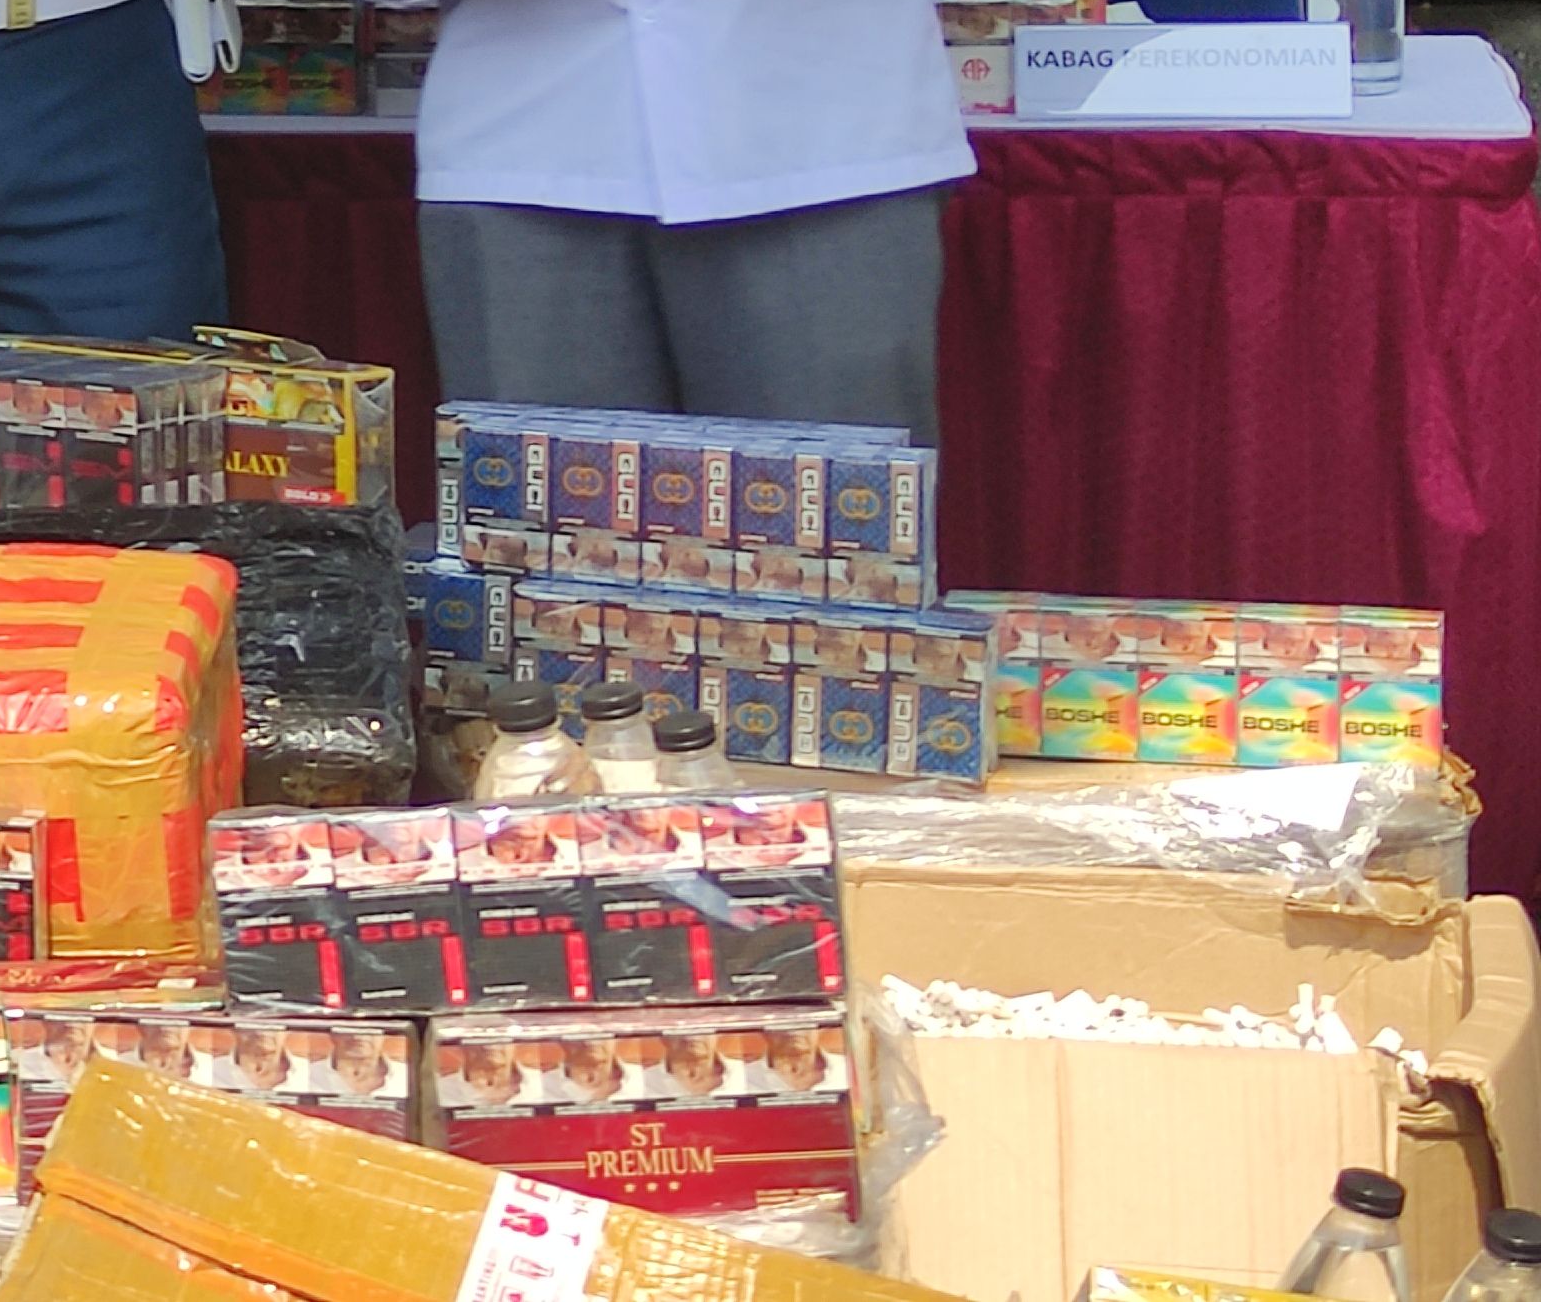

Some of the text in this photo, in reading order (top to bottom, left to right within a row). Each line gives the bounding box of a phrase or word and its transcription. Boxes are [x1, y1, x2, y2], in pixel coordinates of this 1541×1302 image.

[1025, 47, 1337, 69] KABAG PEREKONOMIAN
[226, 450, 291, 478] ALAXY
[1045, 706, 1120, 726] BOSHE
[1141, 709, 1218, 730] BOSHE
[1242, 715, 1320, 735] BOSHE
[1344, 719, 1423, 739] BOSHE
[629, 1122, 666, 1148] ST
[585, 1145, 715, 1180] PREMIUM
